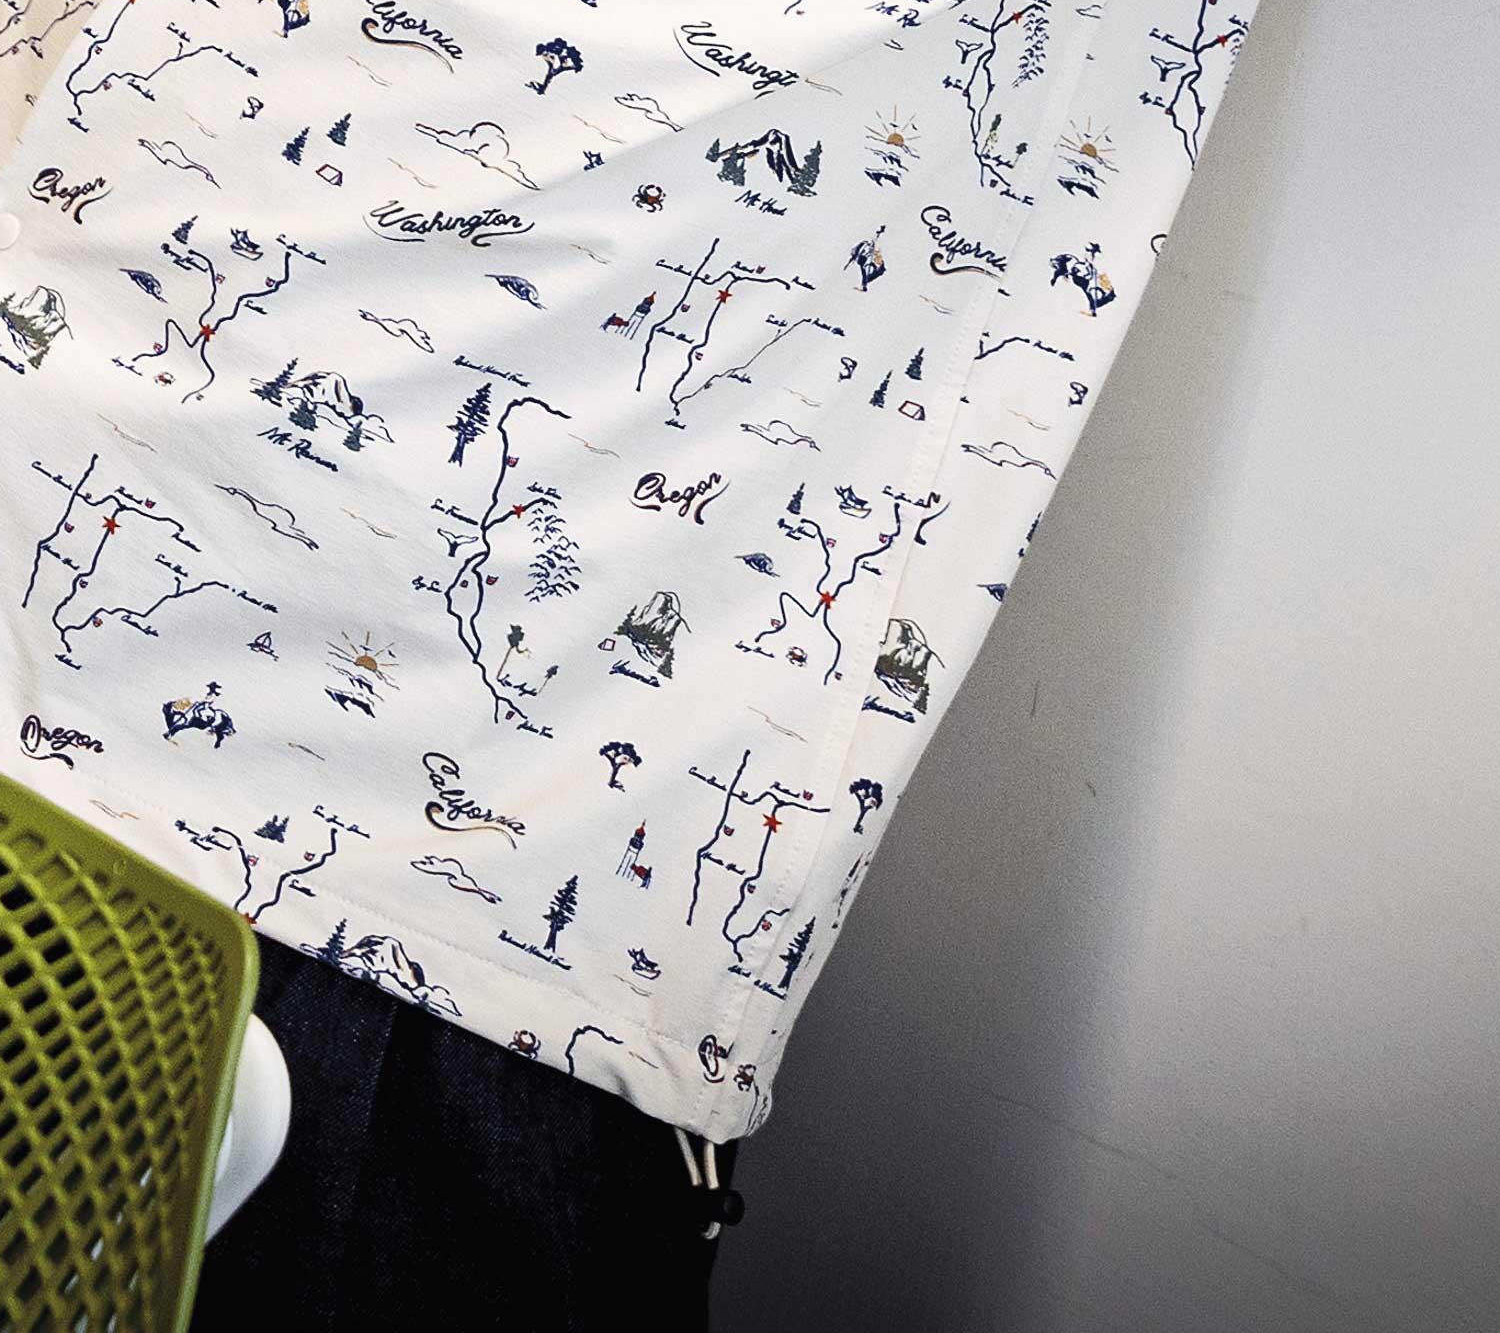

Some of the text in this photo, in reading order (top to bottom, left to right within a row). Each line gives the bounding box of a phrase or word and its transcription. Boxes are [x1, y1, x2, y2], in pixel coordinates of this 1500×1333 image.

[680, 20, 801, 91] Washingt
[30, 166, 109, 217] Oregon
[368, 200, 536, 243] Washington
[633, 471, 722, 521] Oregon
[20, 714, 104, 763] Oregon
